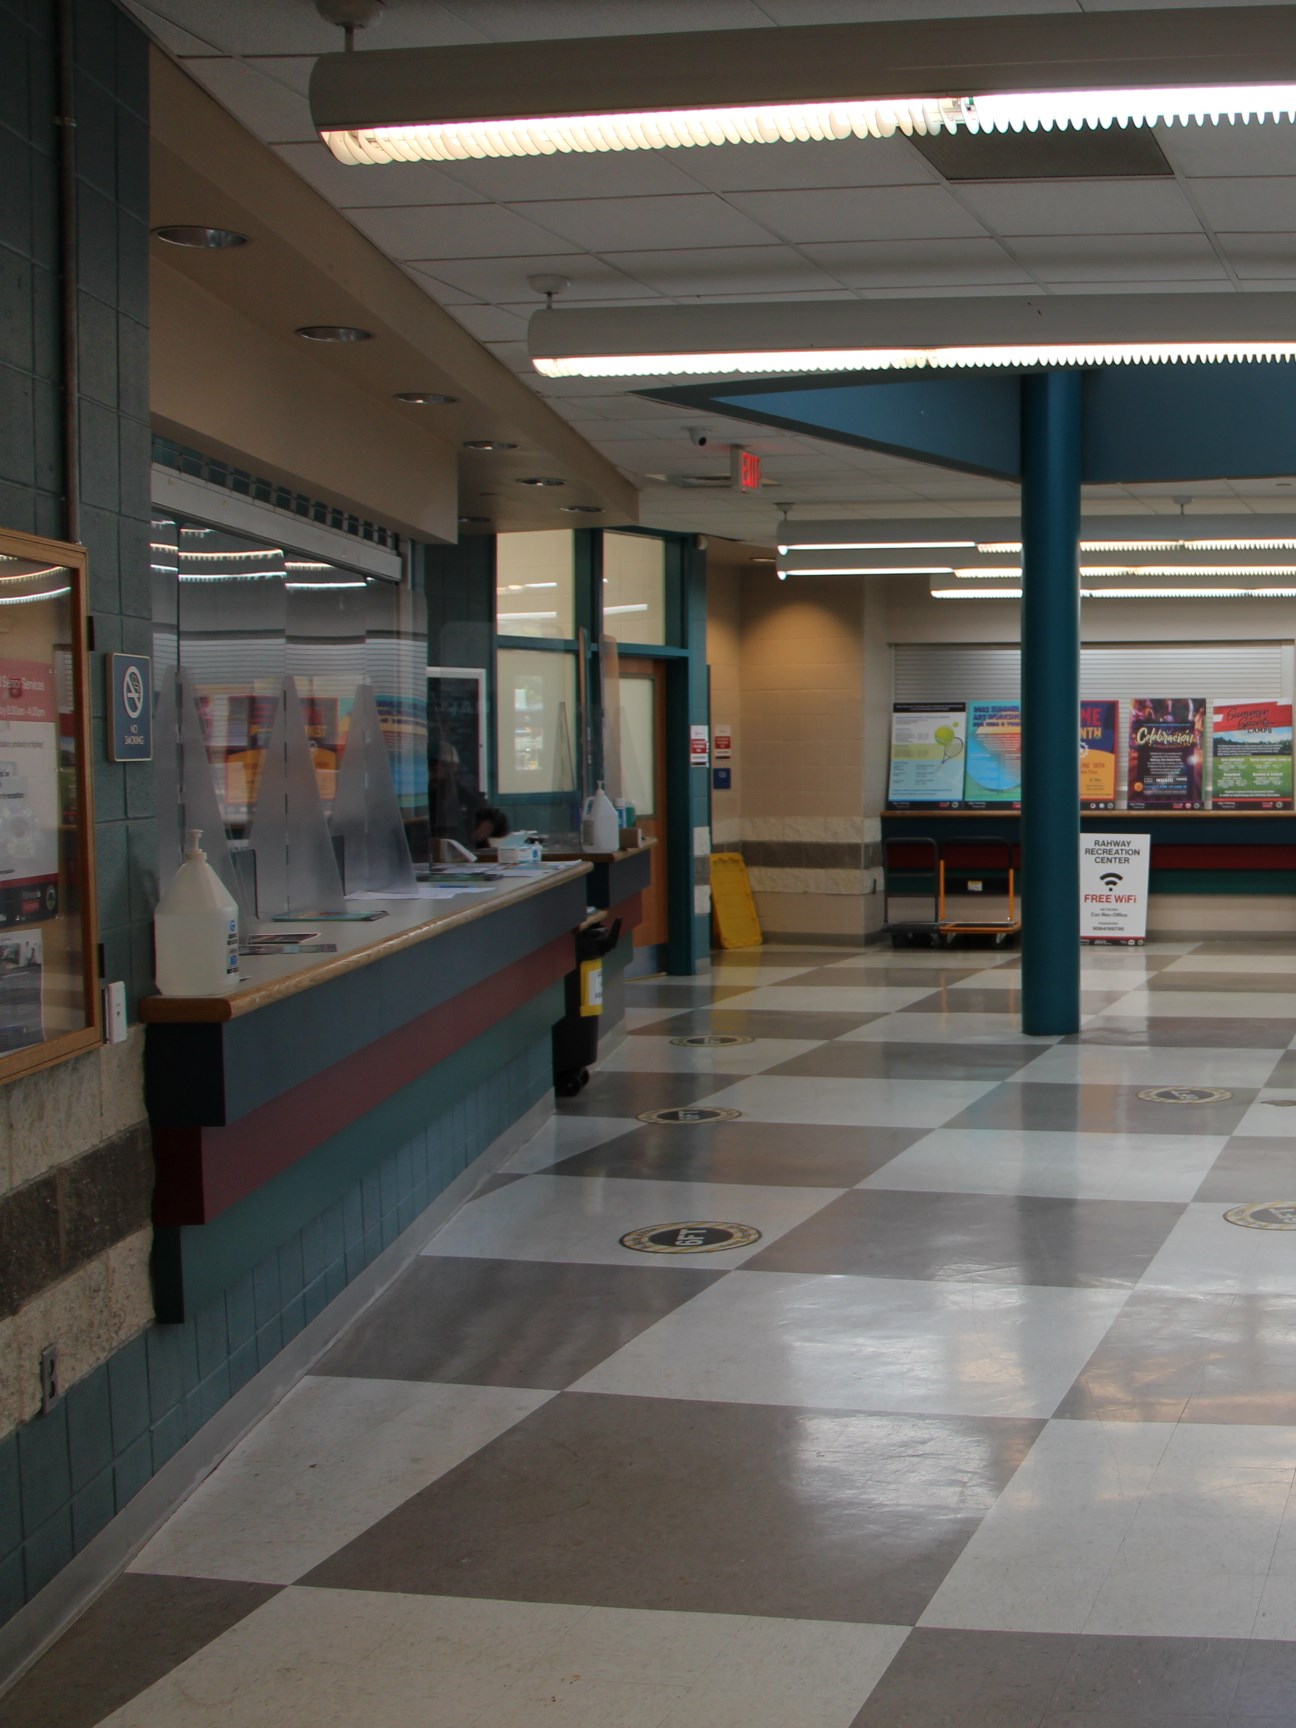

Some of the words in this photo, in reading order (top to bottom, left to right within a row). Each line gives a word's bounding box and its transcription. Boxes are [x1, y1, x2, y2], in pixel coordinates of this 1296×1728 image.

[1227, 707, 1270, 721] Summer
[130, 725, 138, 734] NO
[124, 736, 144, 745] SMOKING
[1136, 727, 1193, 746] Celebración
[1094, 839, 1131, 848] RAHWAY
[1084, 848, 1140, 856] RECREATION
[1094, 856, 1130, 864] CENTER
[1083, 894, 1112, 903] FREE
[1114, 894, 1137, 903] WiFi
[674, 1229, 708, 1246] 6FT
